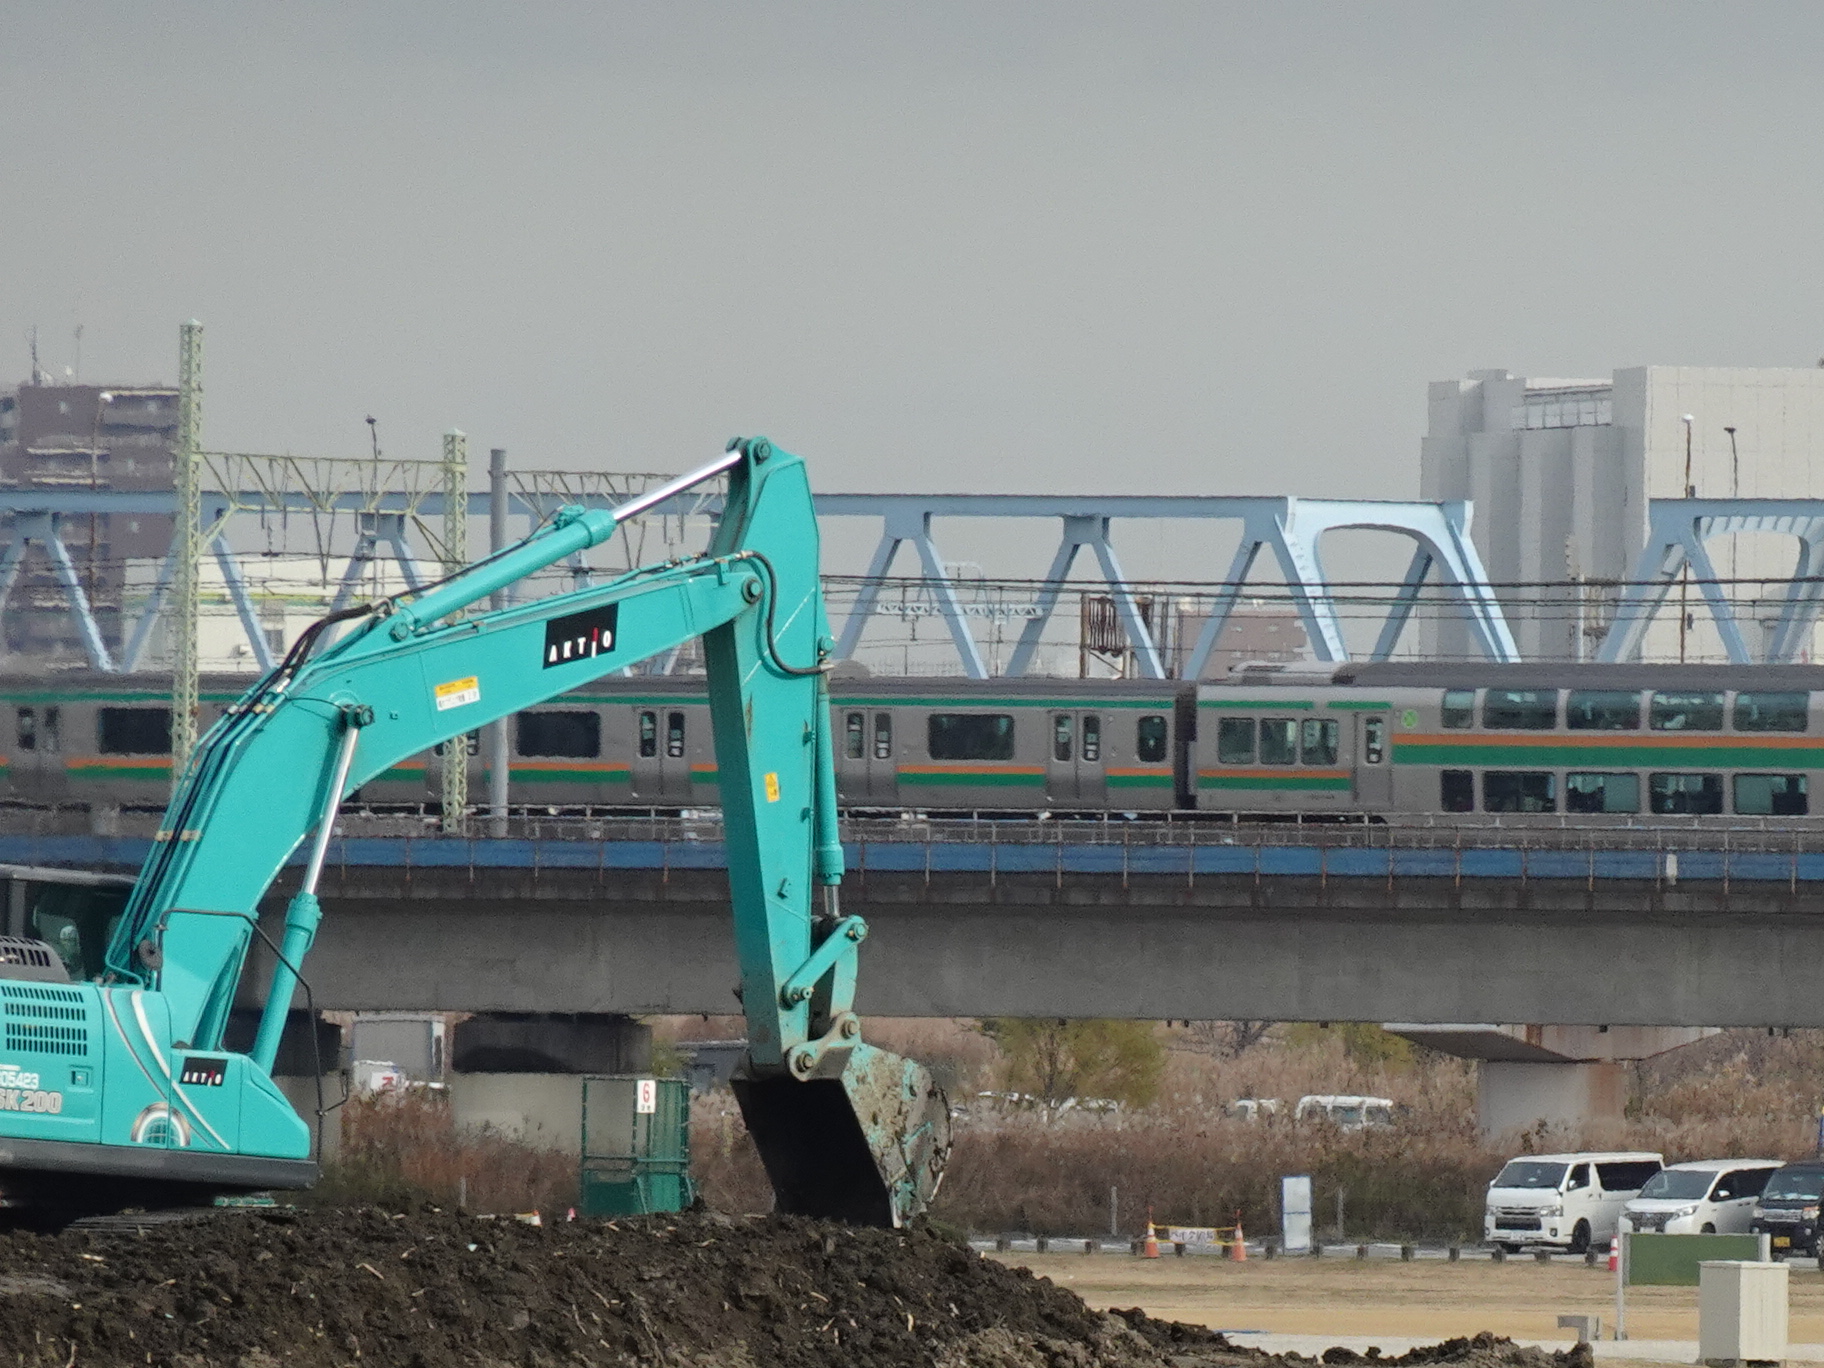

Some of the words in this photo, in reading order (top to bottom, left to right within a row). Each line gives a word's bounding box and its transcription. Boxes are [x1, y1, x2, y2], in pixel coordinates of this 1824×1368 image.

[548, 627, 612, 663] AKTIO
[183, 1070, 222, 1087] AKTIO
[642, 1082, 651, 1103] 6
